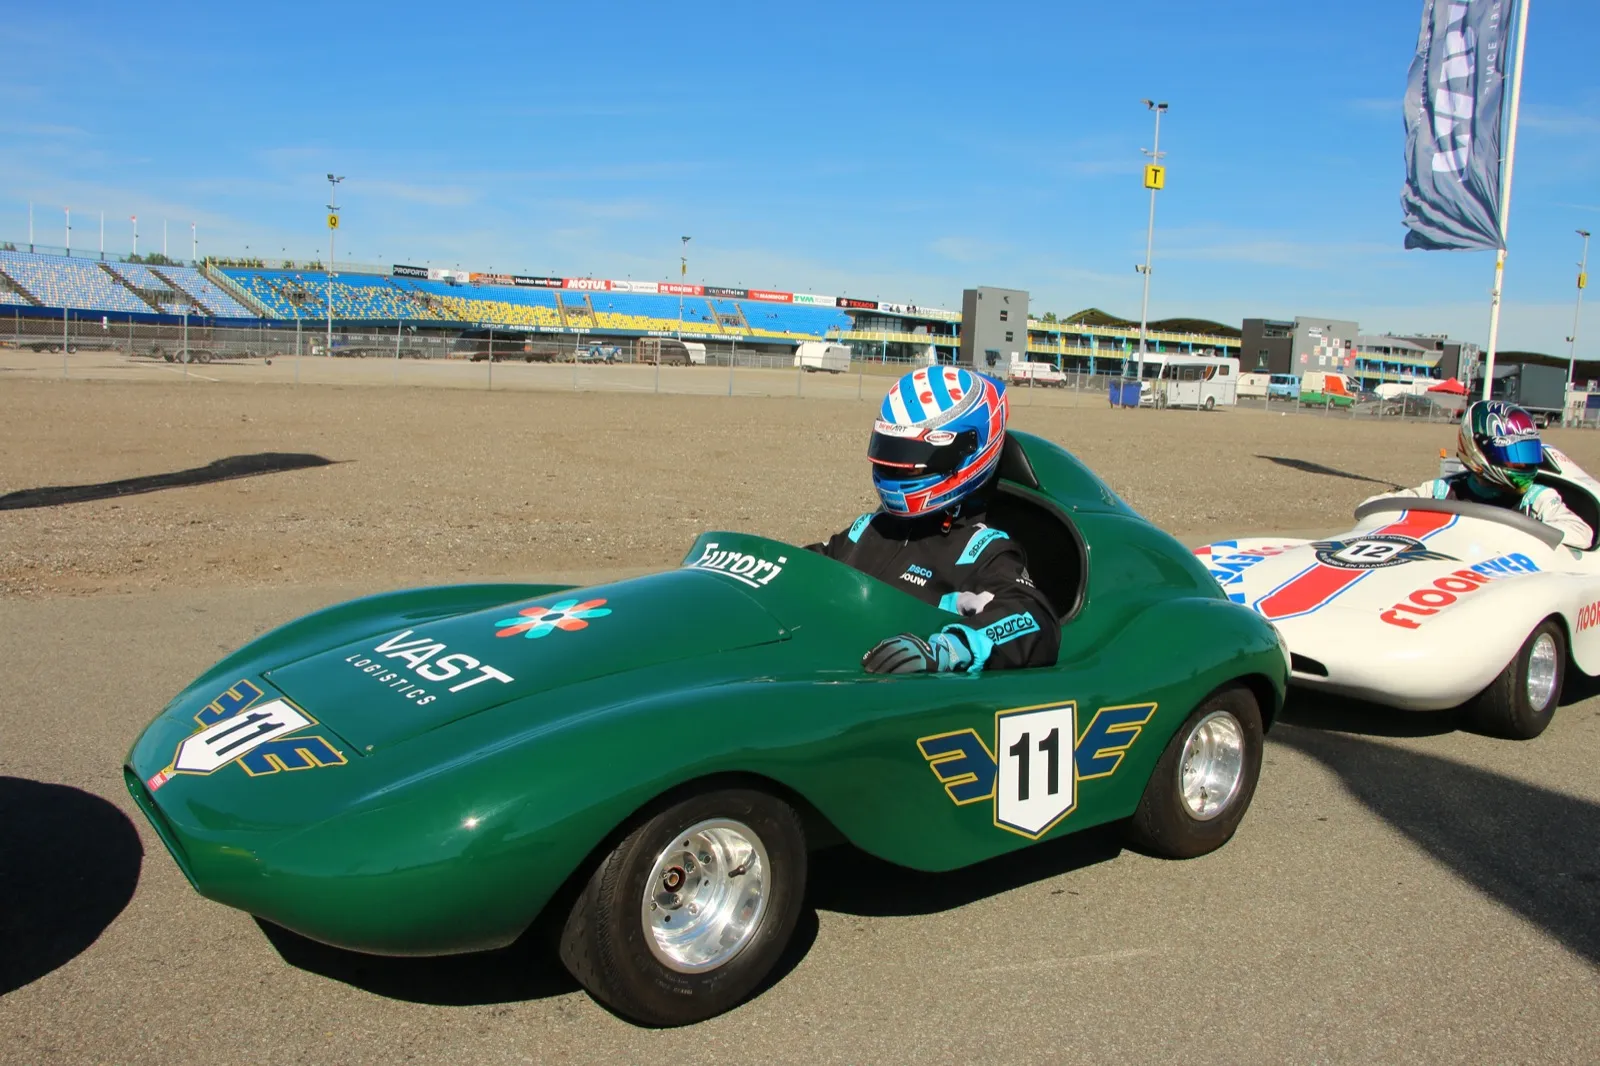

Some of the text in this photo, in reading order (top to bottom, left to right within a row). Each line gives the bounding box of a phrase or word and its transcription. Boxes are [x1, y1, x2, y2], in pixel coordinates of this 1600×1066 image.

[1151, 168, 1161, 184] T
[330, 216, 337, 227] Q
[567, 279, 607, 290] MOTUL
[794, 295, 814, 303] TVM
[850, 300, 875, 309] TEXACO
[711, 333, 744, 341] TRIBUNE
[1350, 544, 1394, 558] 12
[985, 616, 1036, 643] sparco
[374, 630, 515, 693] VAST
[345, 654, 437, 705] LOGISTICS
[204, 712, 286, 757] 11
[1009, 727, 1059, 802] 11
